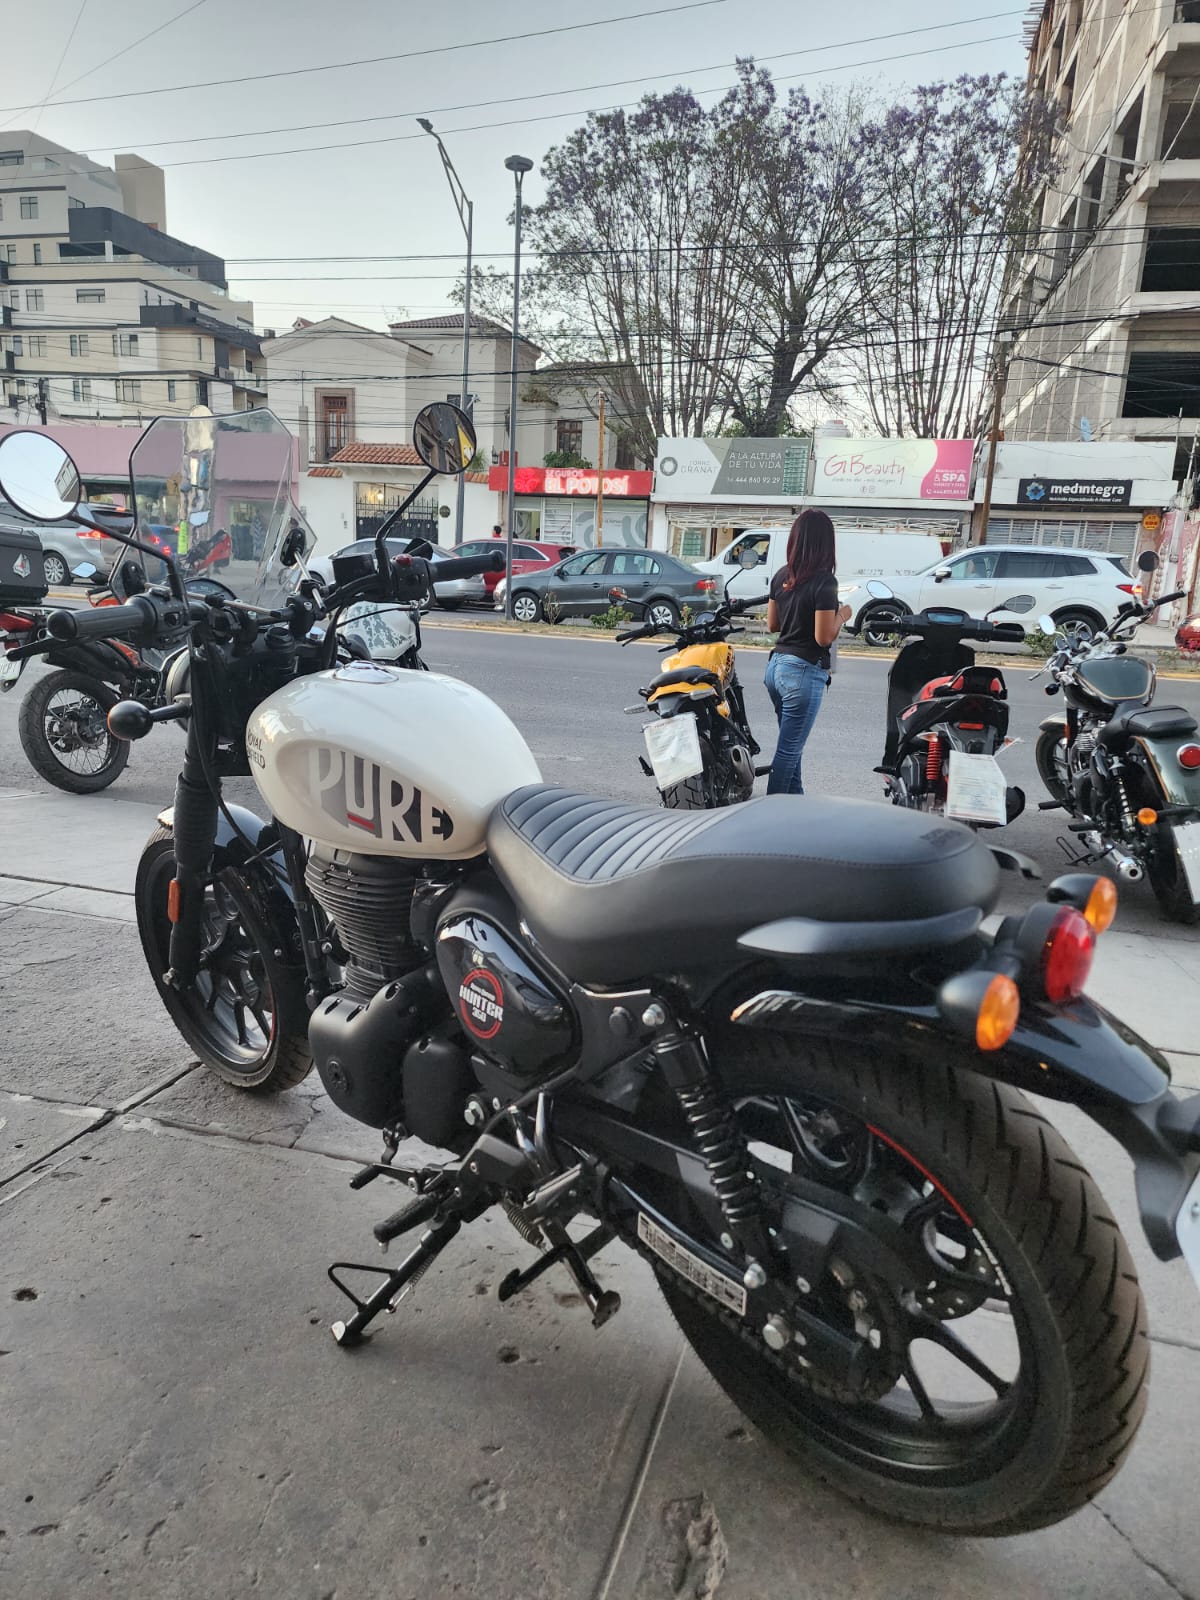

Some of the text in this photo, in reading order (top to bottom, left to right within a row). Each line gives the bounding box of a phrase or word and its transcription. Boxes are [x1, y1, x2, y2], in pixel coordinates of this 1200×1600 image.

[738, 452, 748, 460] LA
[750, 452, 782, 460] ALTURA
[728, 460, 782, 469] DE TU VIDA
[850, 454, 905, 485] Beauty
[545, 469, 584, 478] SEGUROS
[942, 473, 966, 483] SPA
[544, 477, 566, 493] EL
[1050, 482, 1125, 498] medintegra
[307, 746, 446, 843] PURE
[459, 984, 504, 1022] HUNTER
